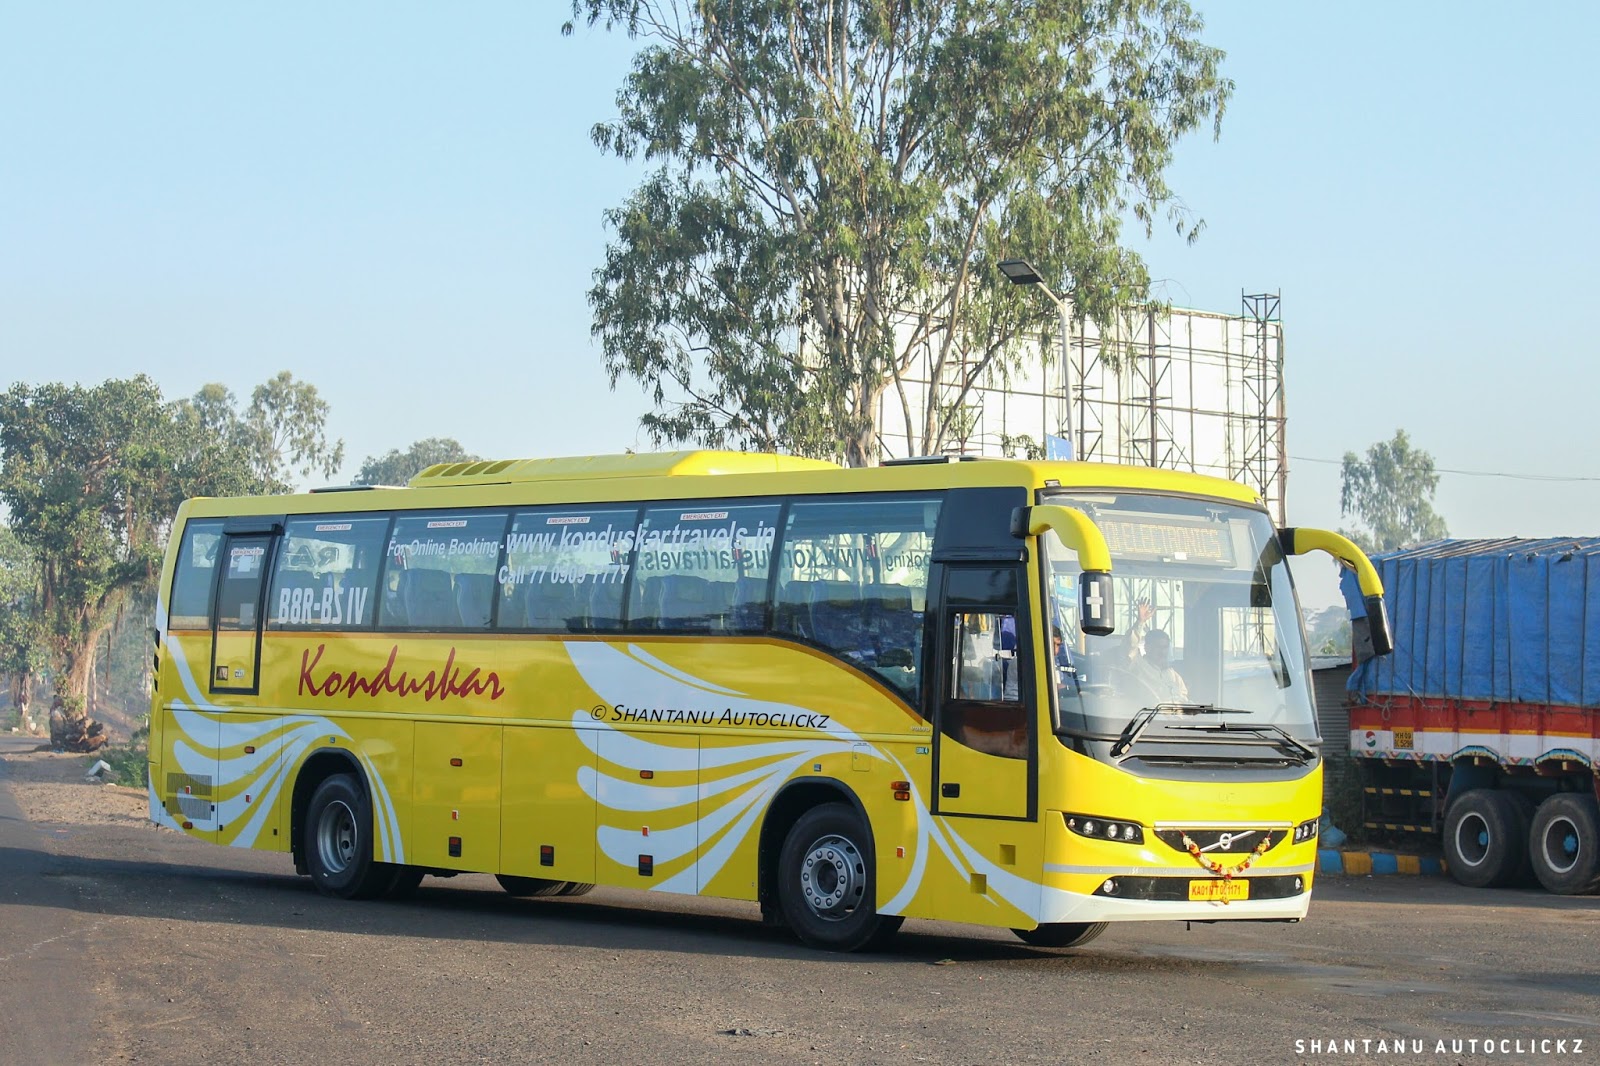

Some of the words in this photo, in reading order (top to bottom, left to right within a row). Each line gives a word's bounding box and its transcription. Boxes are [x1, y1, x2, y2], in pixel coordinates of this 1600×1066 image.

[387, 541, 406, 557] For
[411, 539, 446, 556] Online
[506, 521, 776, 554] www.konduskartravels.in
[499, 565, 525, 584] Call
[530, 565, 548, 584] 77
[278, 587, 344, 625] B8R-BS
[346, 587, 368, 625] IV
[298, 644, 505, 701] Konduskar
